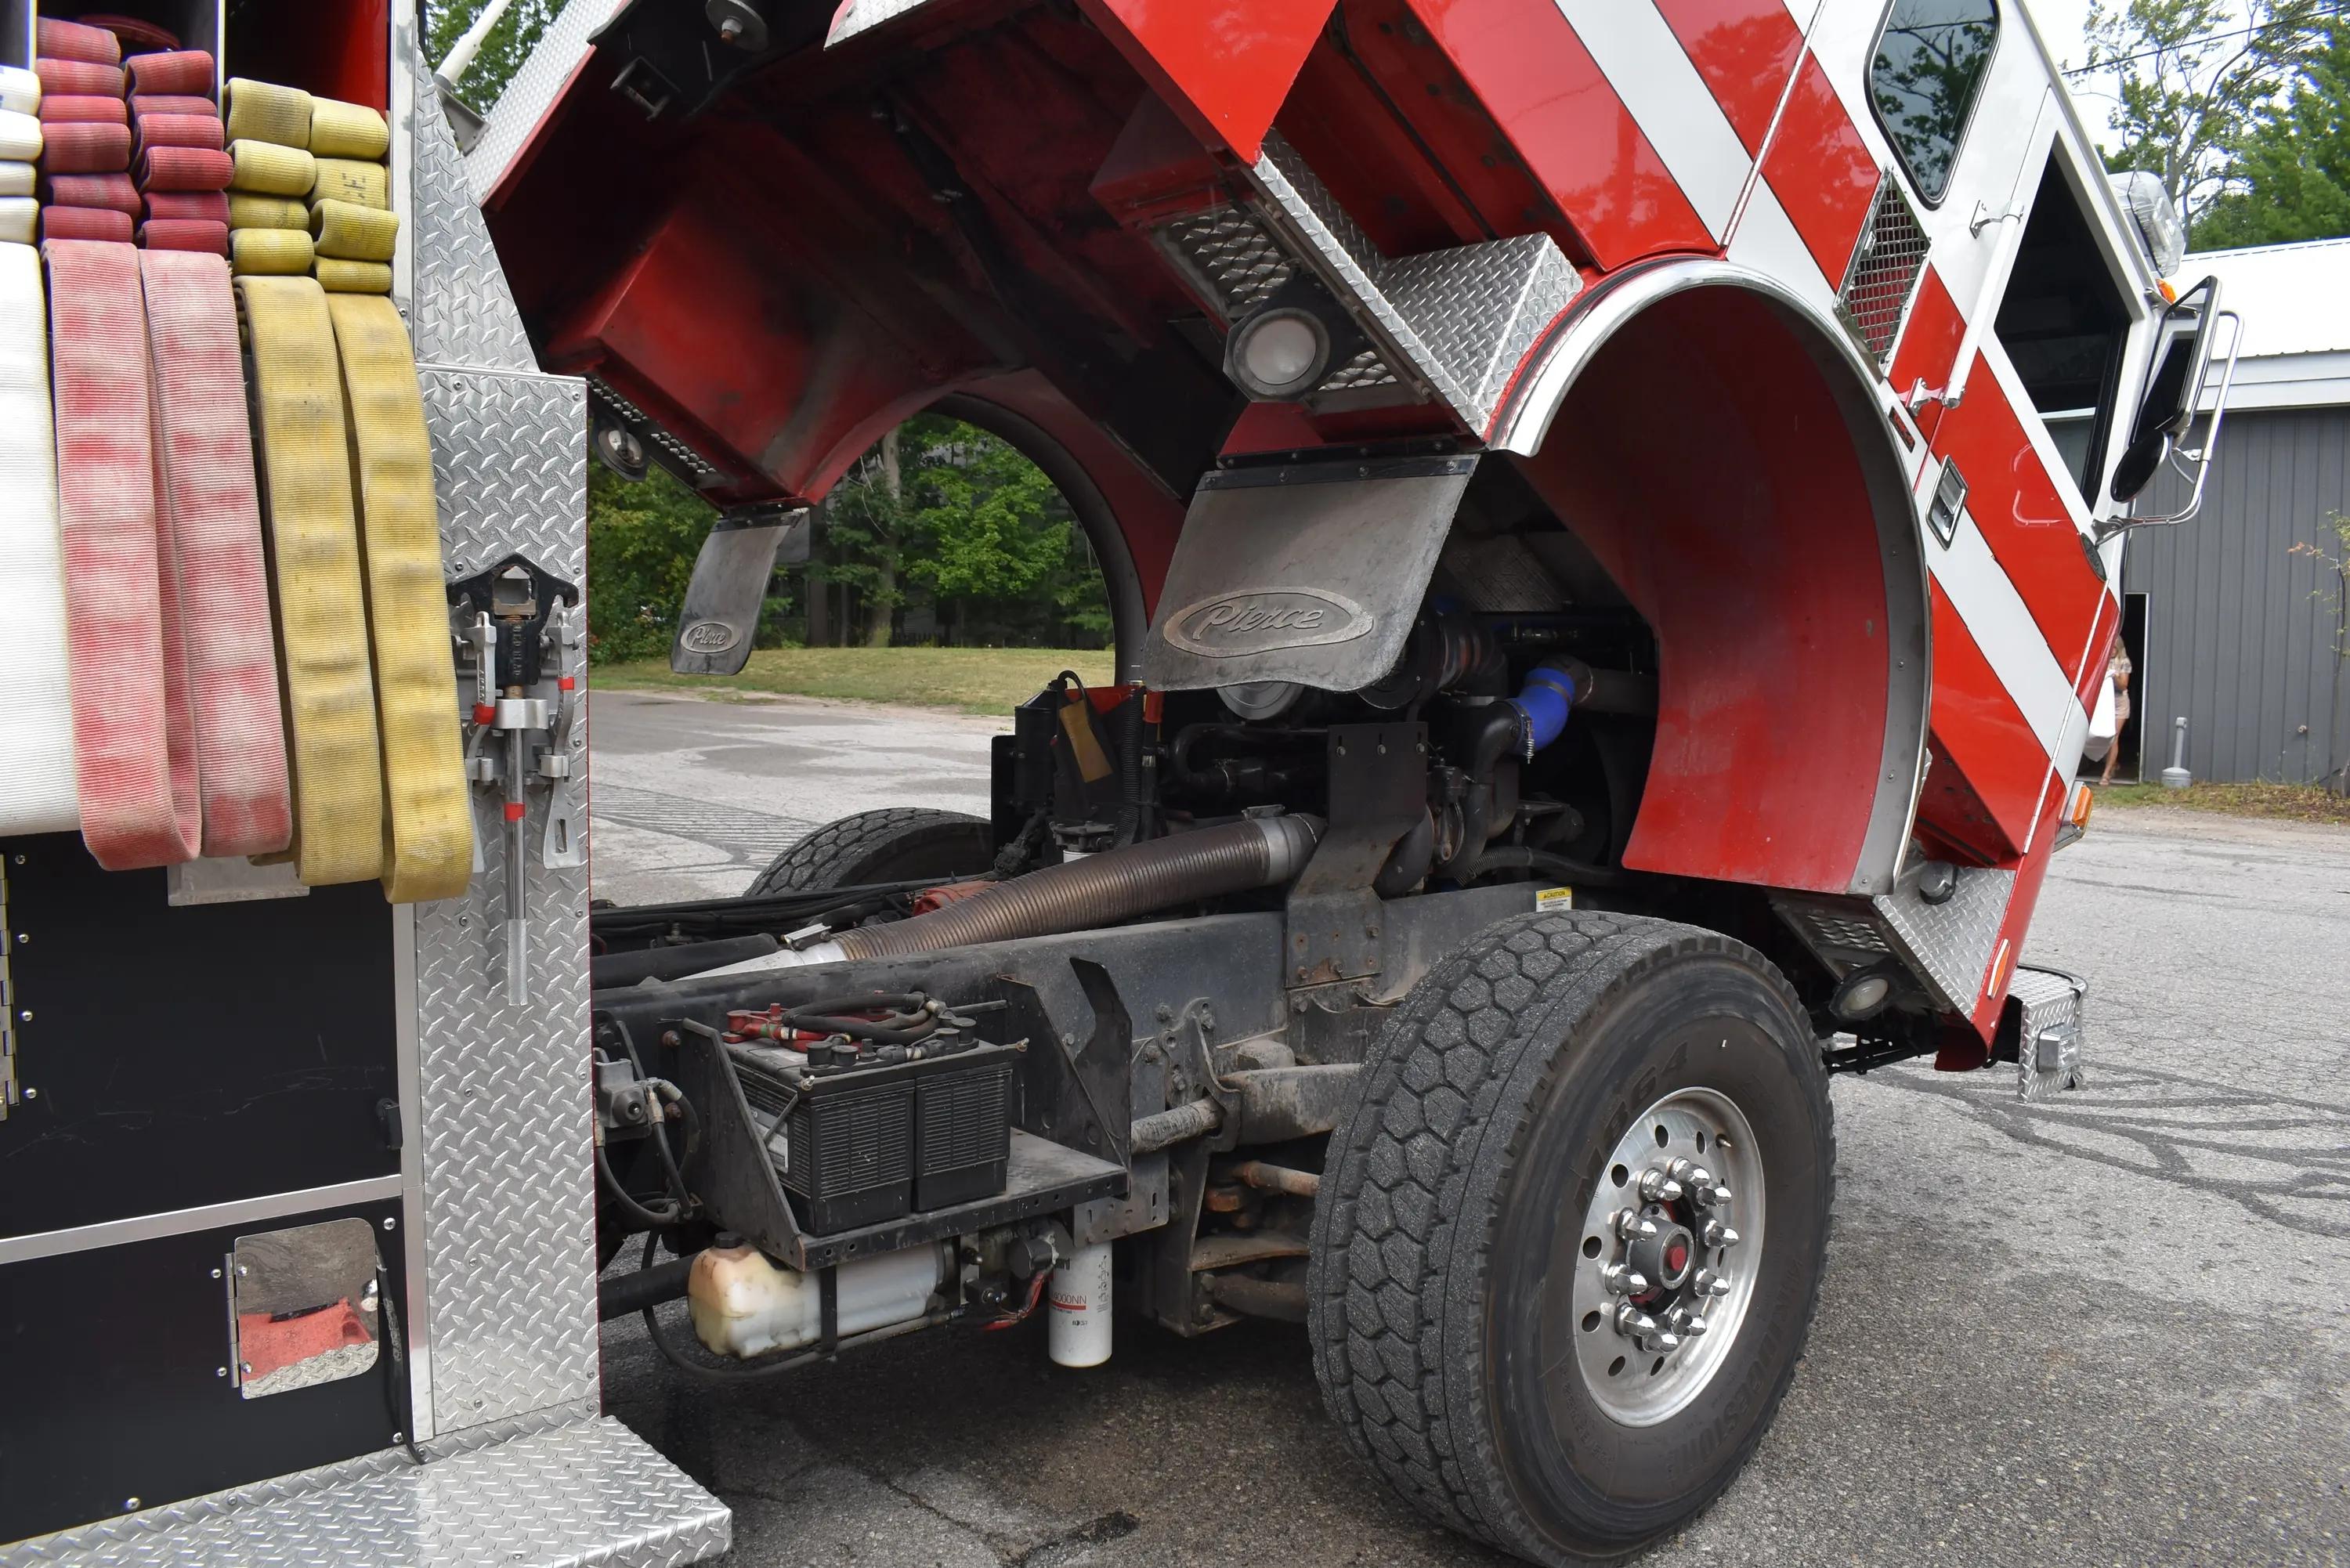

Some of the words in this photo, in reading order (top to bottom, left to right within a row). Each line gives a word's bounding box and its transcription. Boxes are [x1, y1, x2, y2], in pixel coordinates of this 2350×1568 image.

[1191, 603, 1325, 641] Pierce
[689, 627, 728, 649] Pierce
[1052, 1292, 1086, 1304] 4000NN
